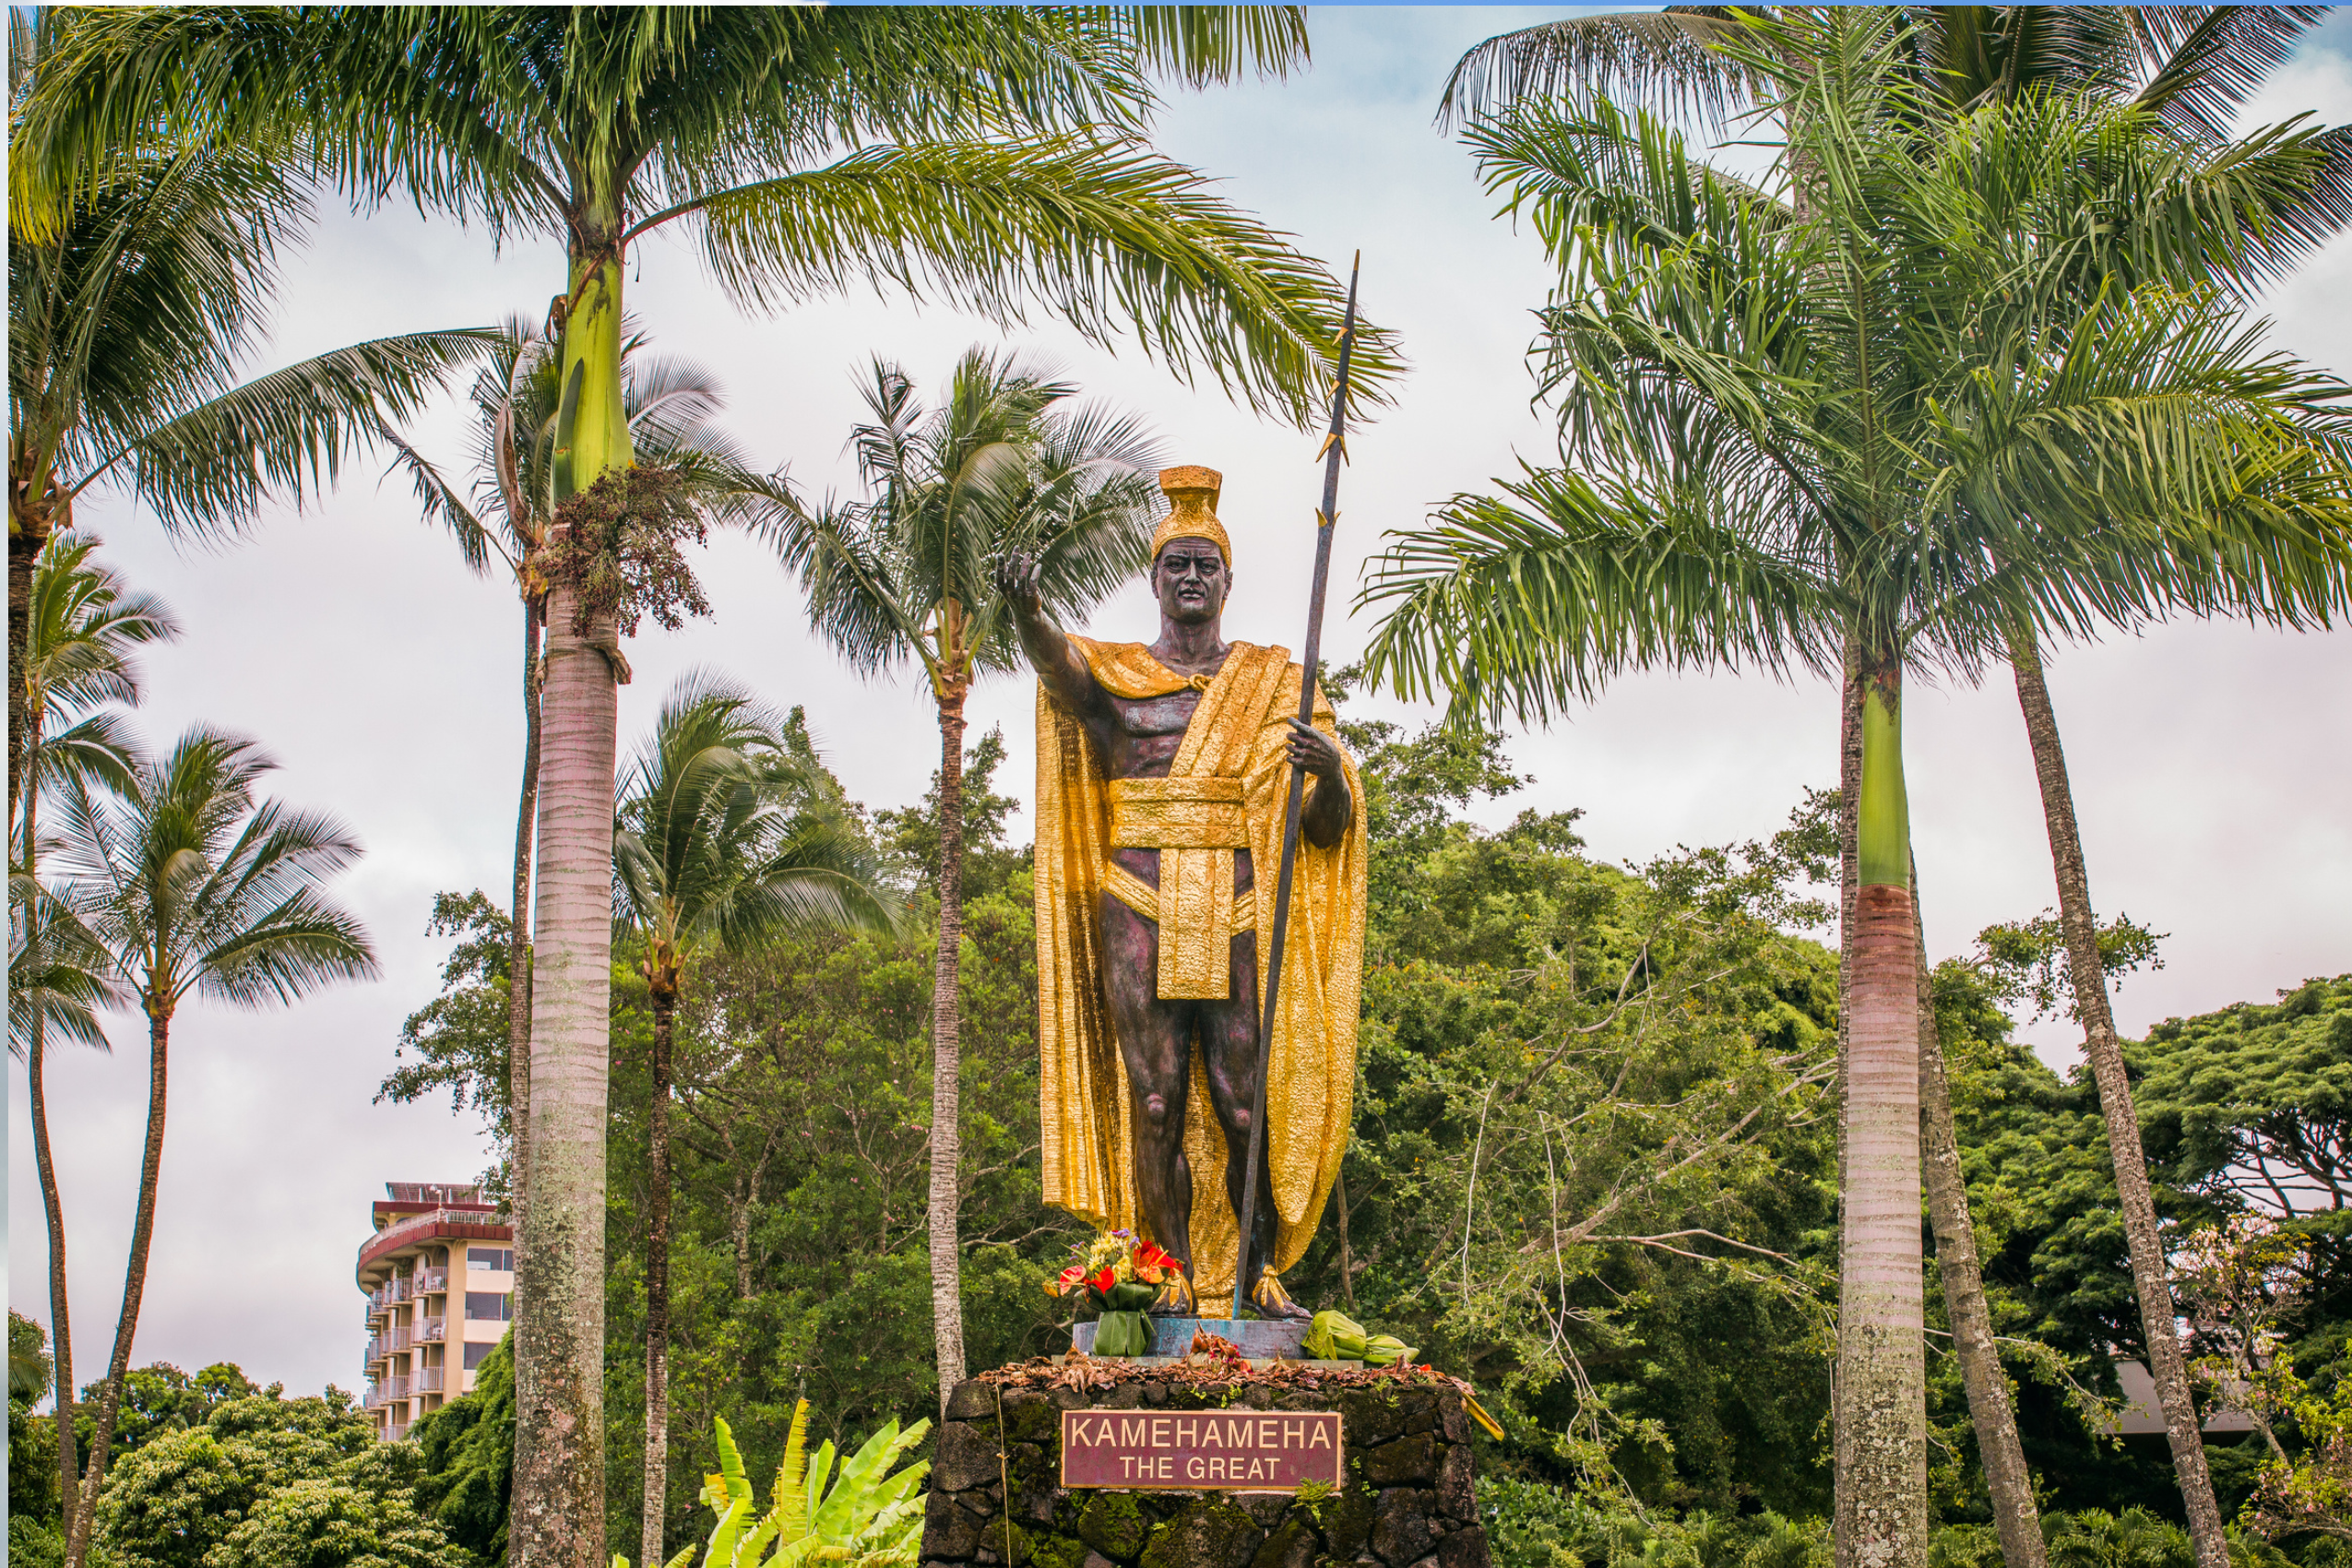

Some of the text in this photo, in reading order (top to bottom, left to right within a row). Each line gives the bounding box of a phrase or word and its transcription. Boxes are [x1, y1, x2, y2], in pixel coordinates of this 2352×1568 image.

[1071, 1418, 1331, 1449] KAMEHAMEHA
[1119, 1456, 1280, 1480] THE GREAT
